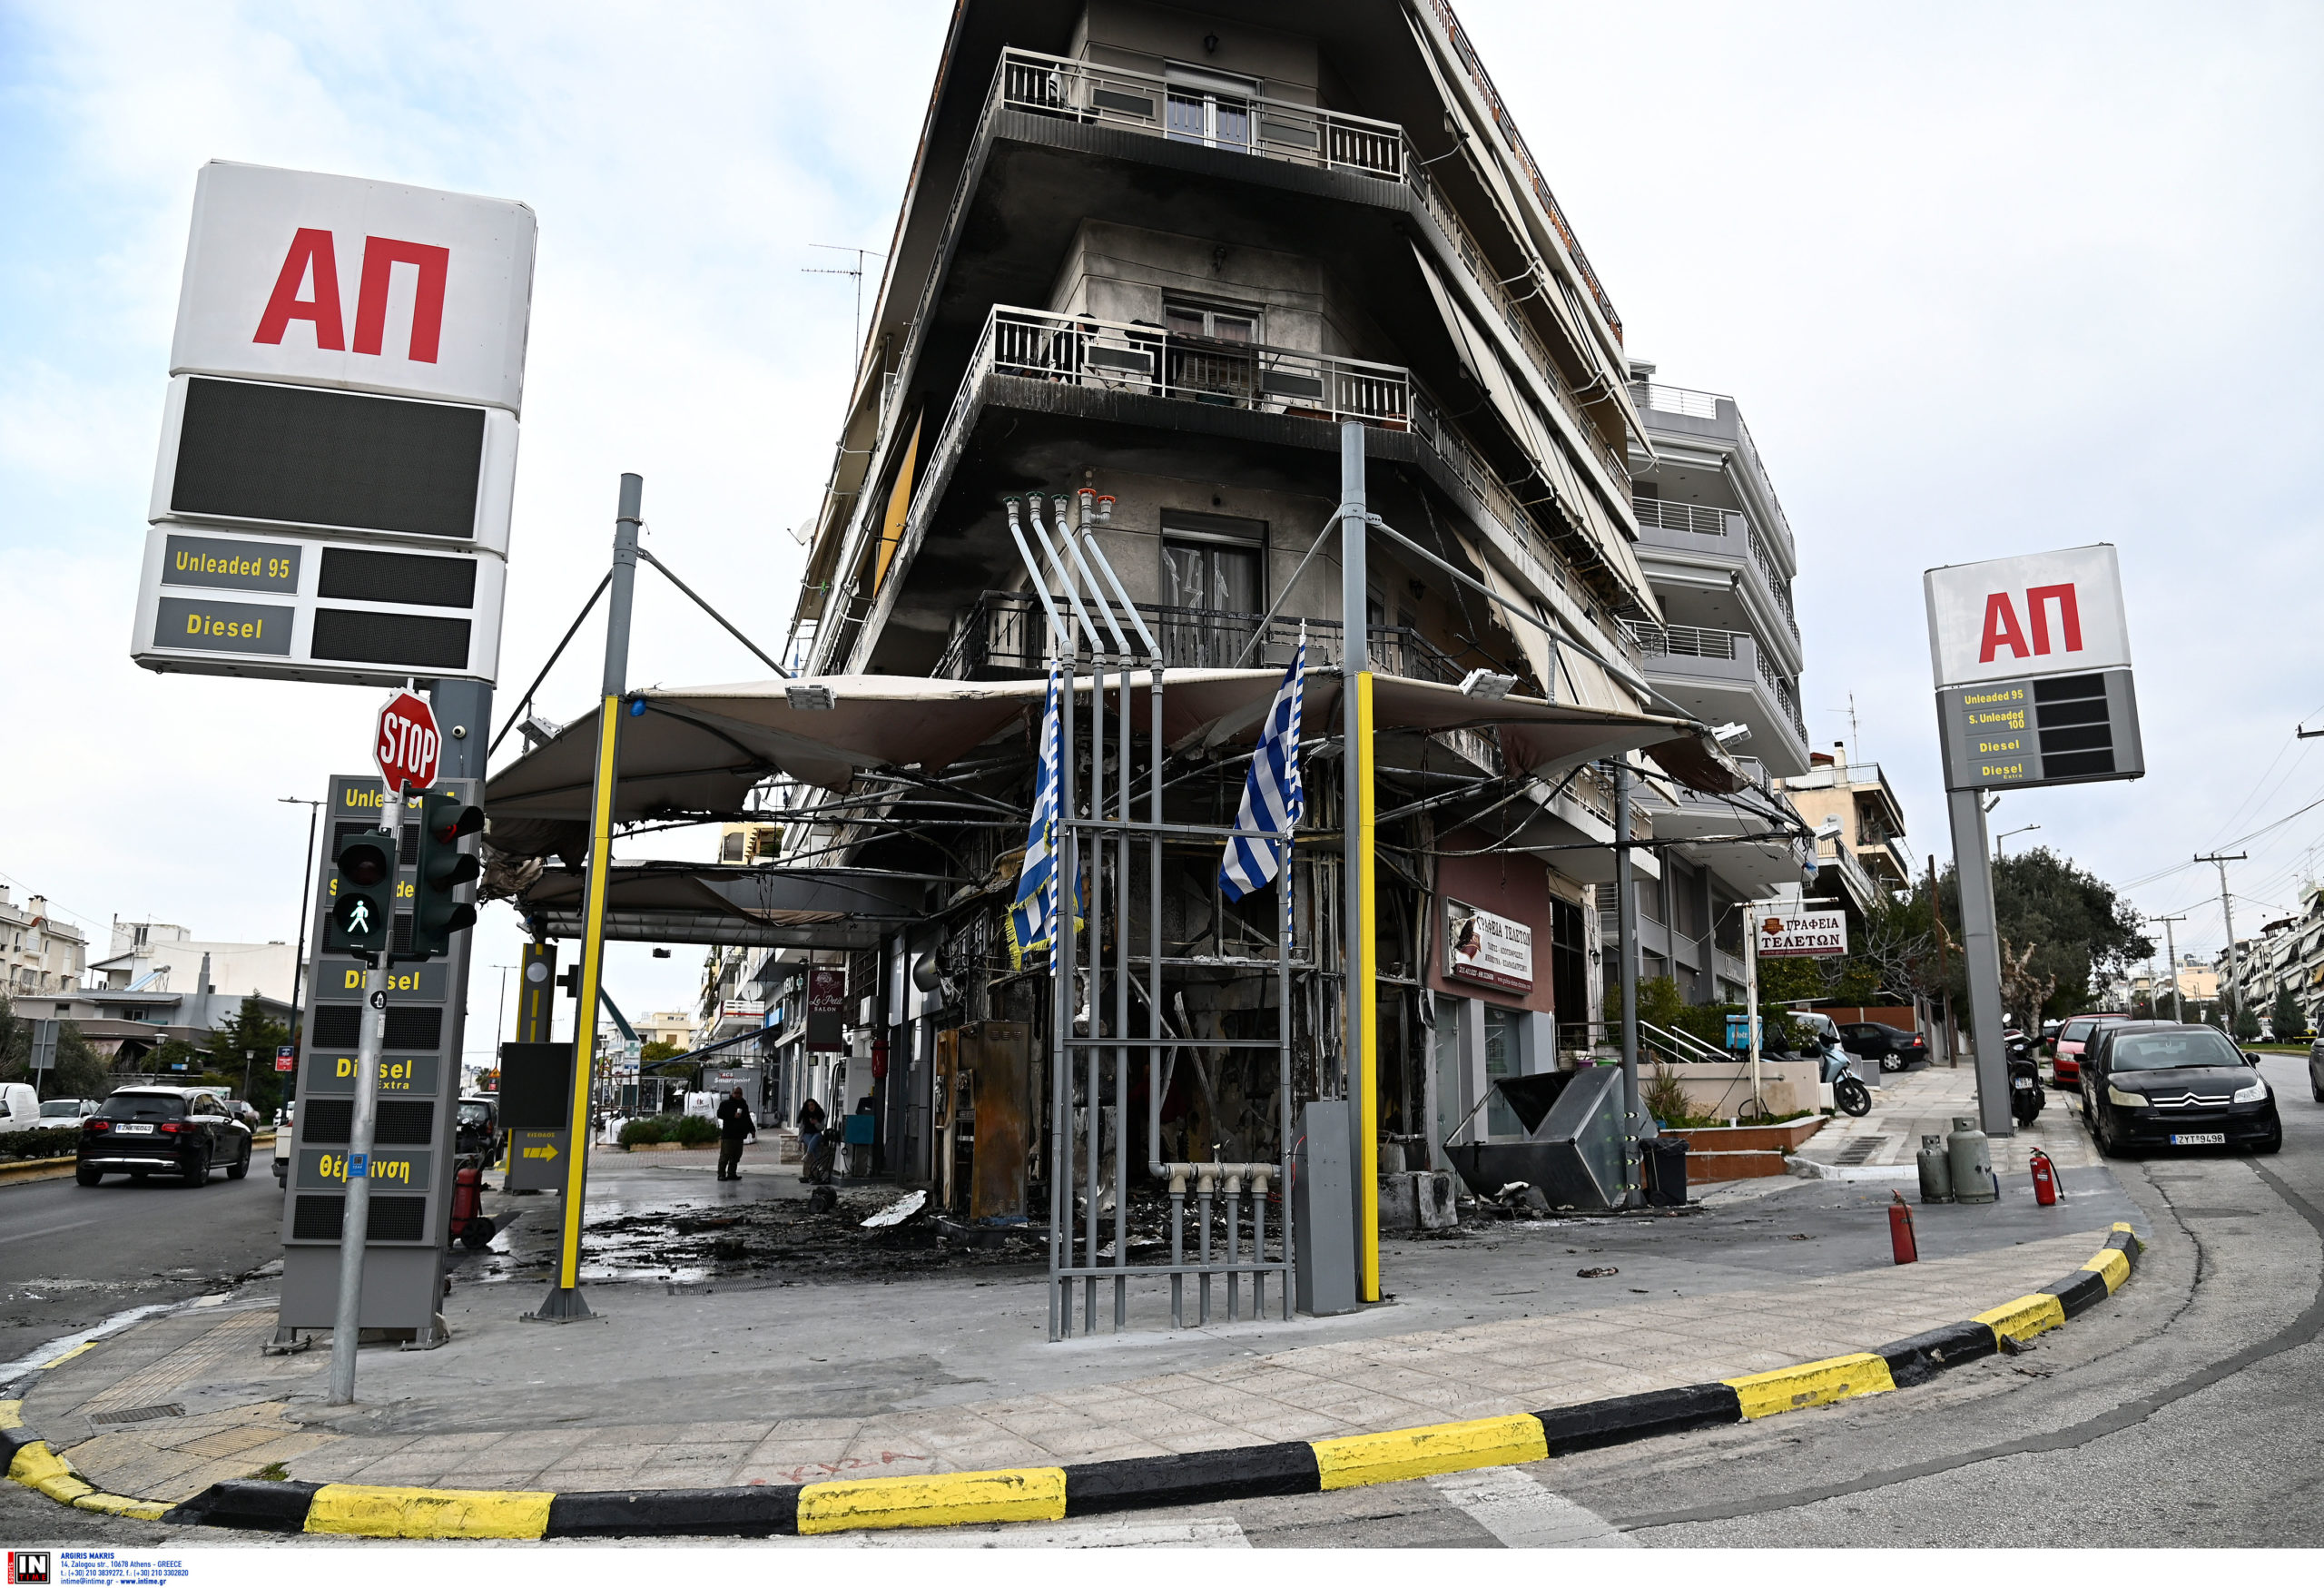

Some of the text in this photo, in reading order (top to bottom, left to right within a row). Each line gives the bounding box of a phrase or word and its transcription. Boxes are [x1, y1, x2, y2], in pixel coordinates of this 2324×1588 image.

[252, 228, 449, 363] ΑΠ
[176, 551, 290, 578] Unleaded 95
[187, 614, 262, 638] Diesel
[1979, 583, 2083, 663] ΑΠ
[1965, 690, 2024, 705] Unleaded 95
[1969, 710, 2024, 724] S. Unleaded
[2008, 719, 2024, 729] 100
[380, 712, 436, 778] STOP
[1980, 740, 2020, 753] Diesel
[1982, 764, 2023, 776] Diesel
[1477, 916, 1502, 937] ΓΡΑΦΕΙΑ
[1787, 918, 1839, 931] ΓΡΑΦΕΙΑ
[1761, 934, 1839, 948] ΤΕΛΕΤΩΝ
[345, 970, 419, 991] Disel
[809, 995, 821, 1005] Le
[336, 1058, 412, 1079] Disel
